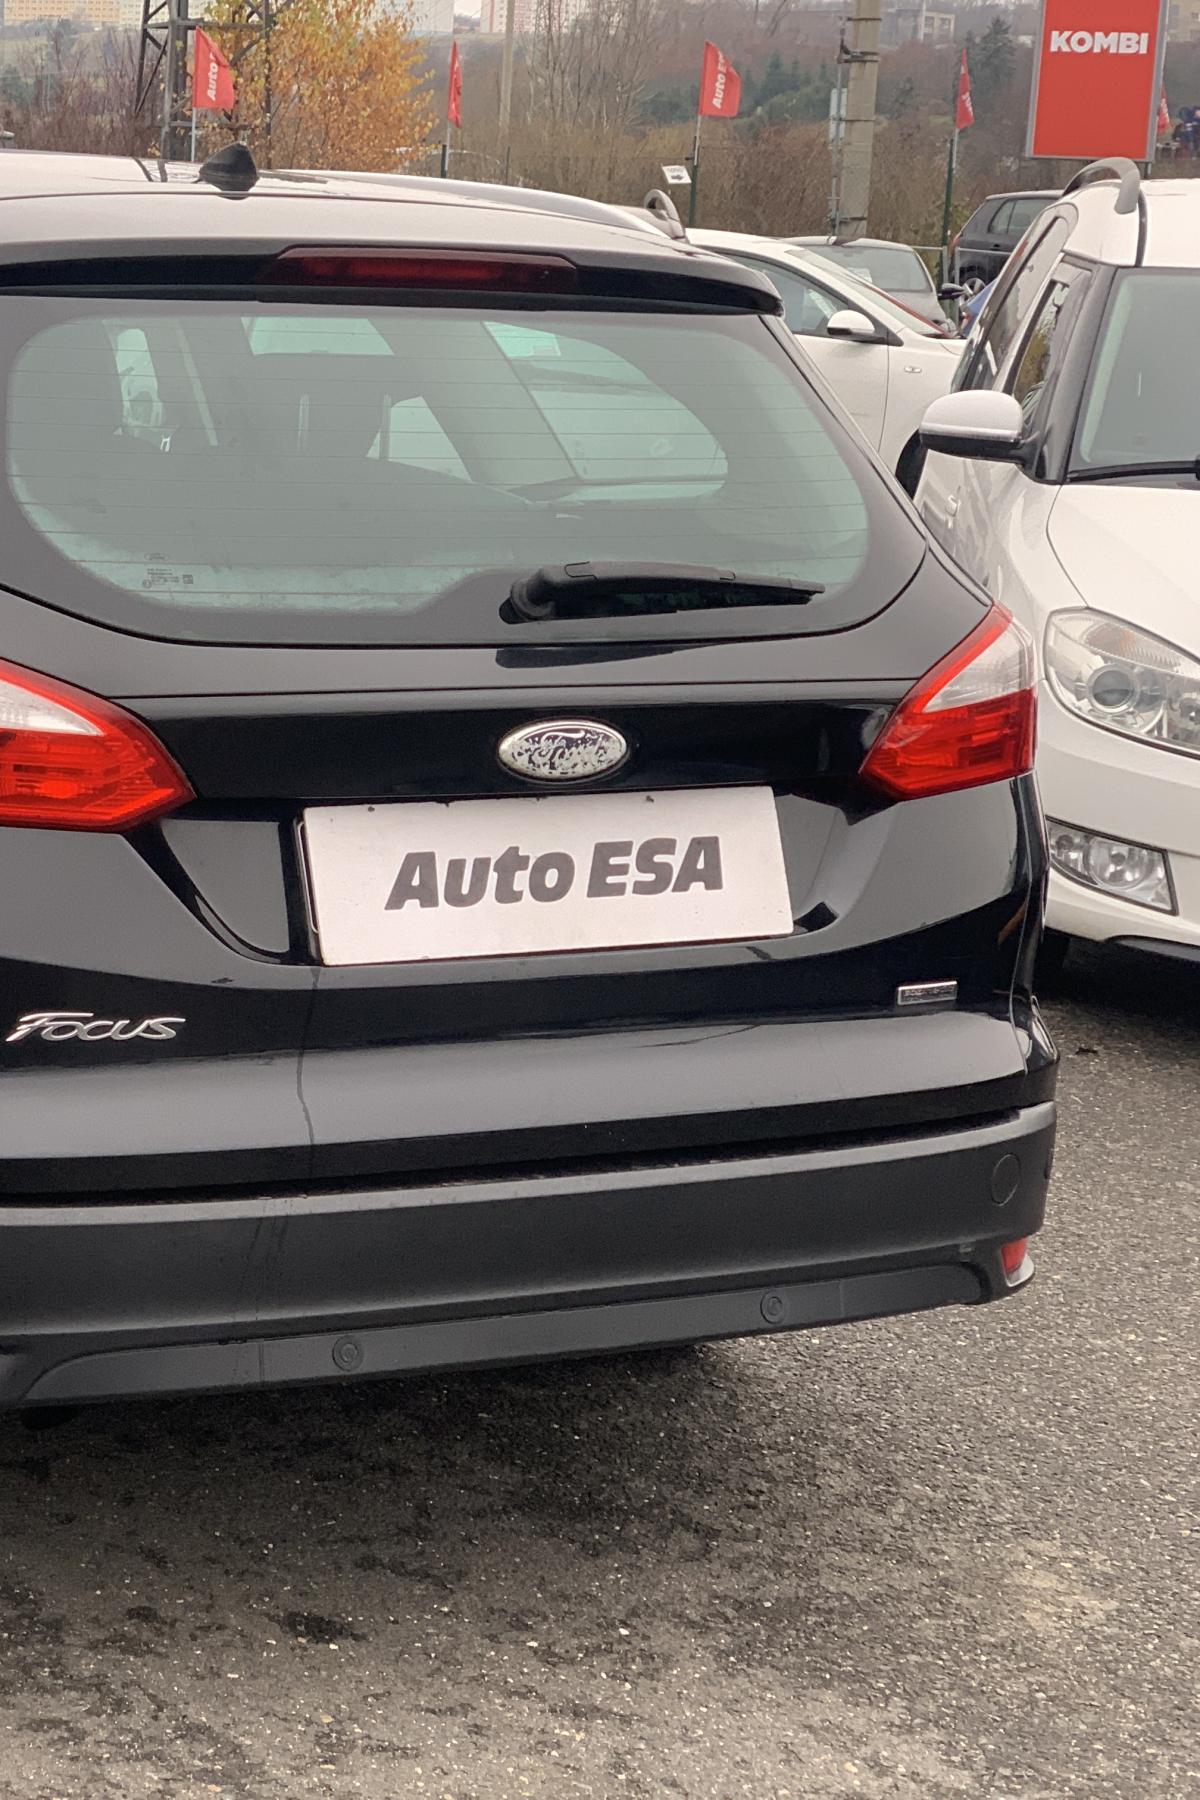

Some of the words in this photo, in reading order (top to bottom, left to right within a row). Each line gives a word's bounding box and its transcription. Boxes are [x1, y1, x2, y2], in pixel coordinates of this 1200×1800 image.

[1050, 31, 1149, 54] KOMBI
[384, 846, 575, 910] Auto
[586, 836, 723, 898] ESA
